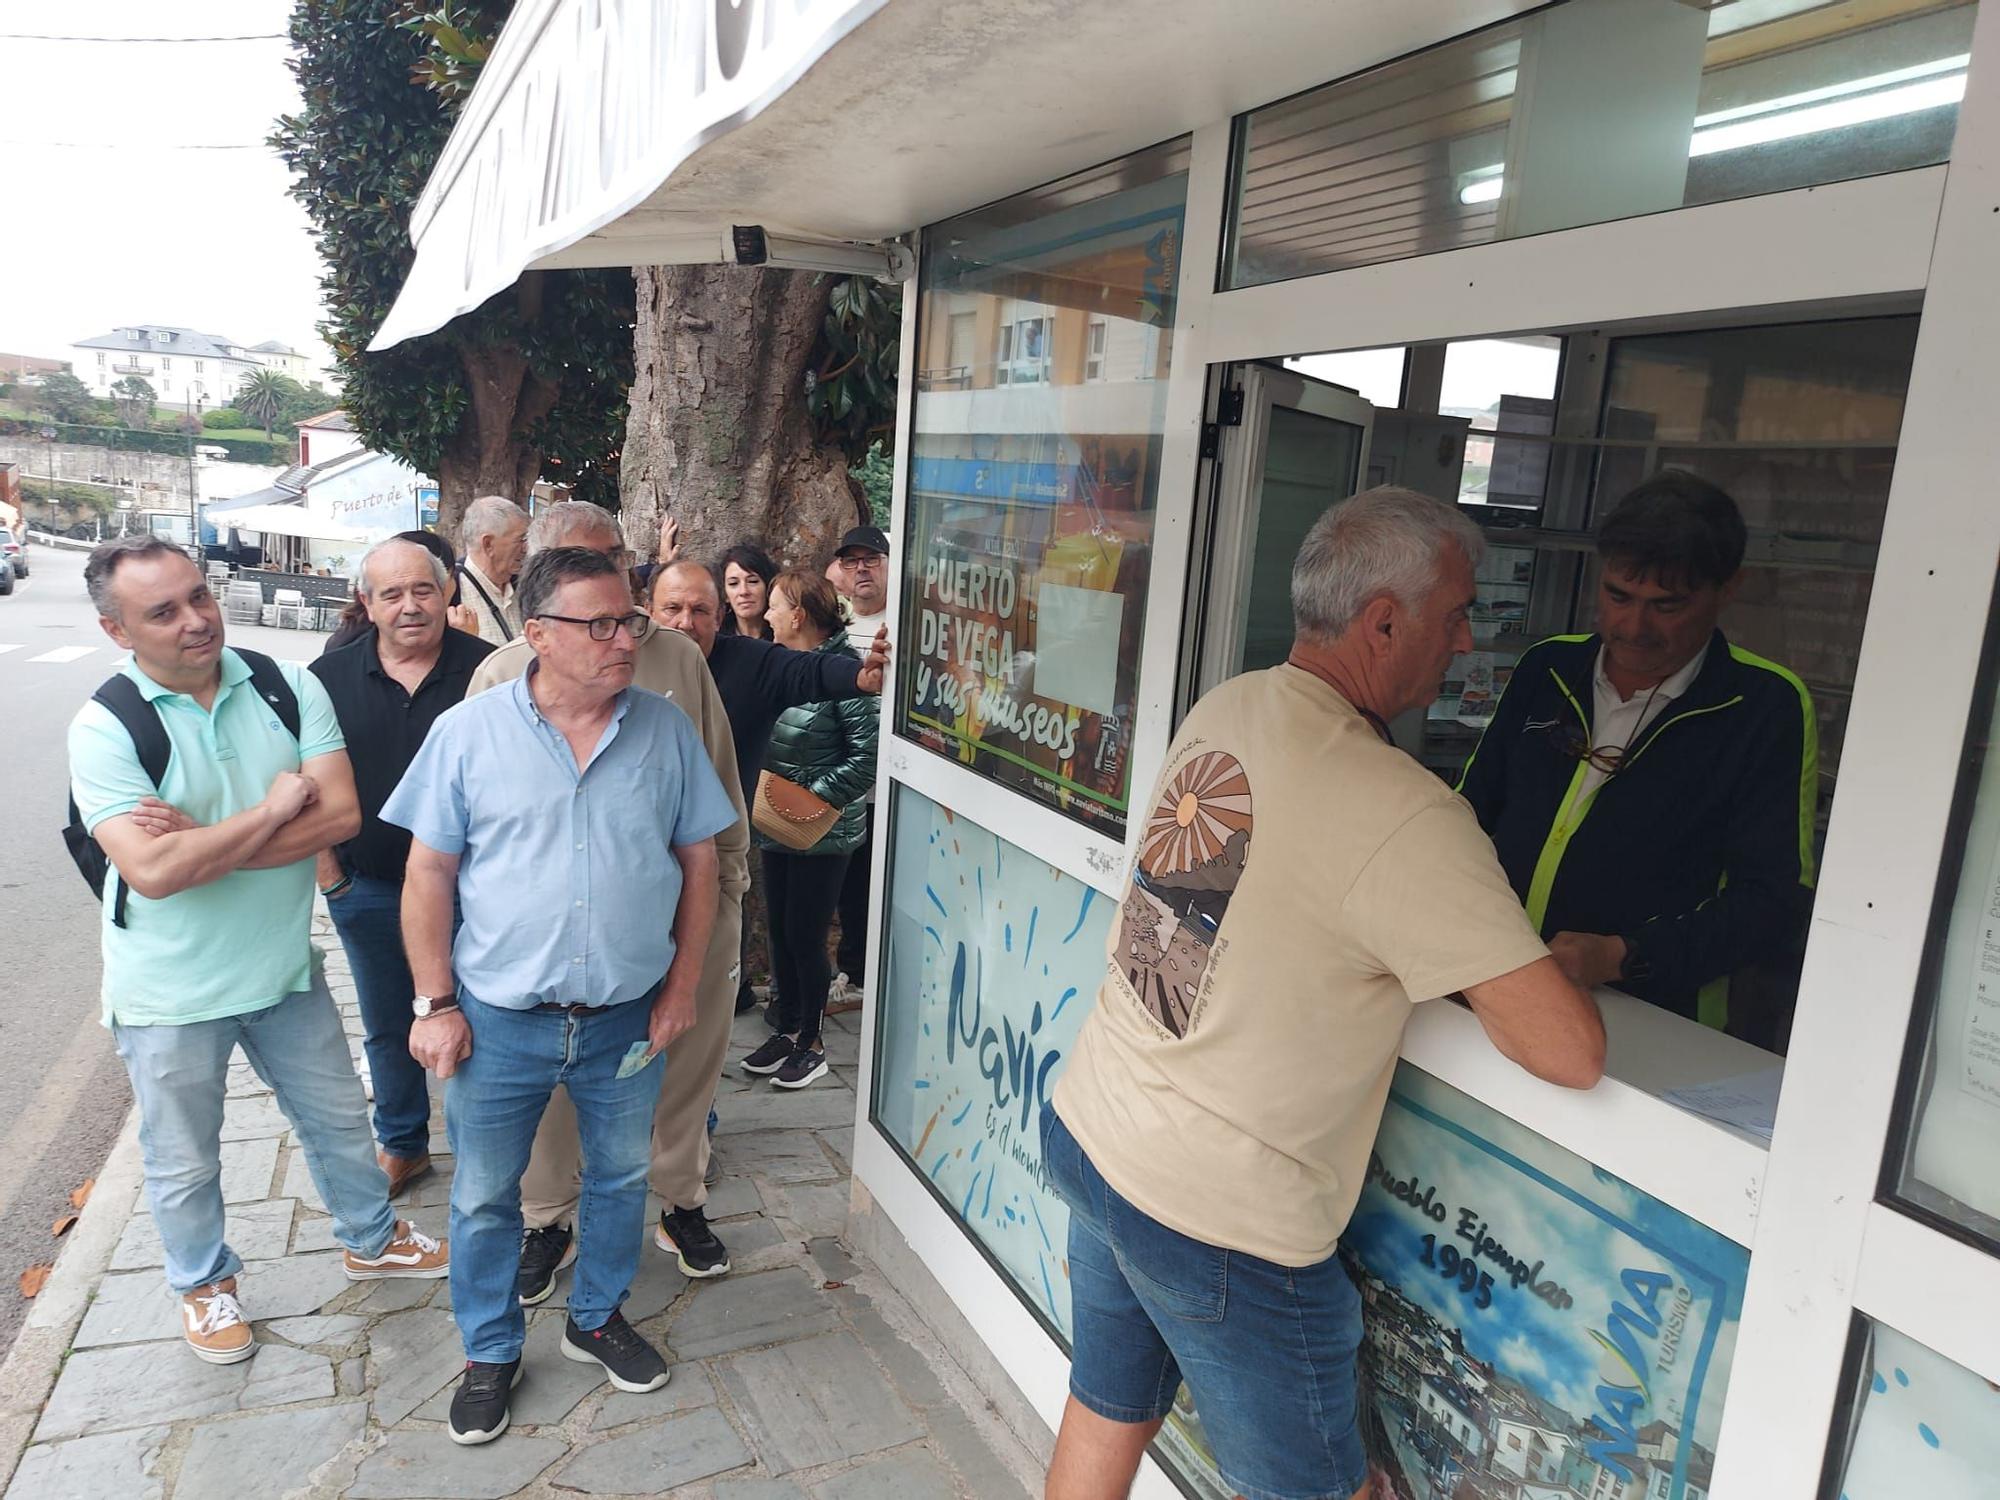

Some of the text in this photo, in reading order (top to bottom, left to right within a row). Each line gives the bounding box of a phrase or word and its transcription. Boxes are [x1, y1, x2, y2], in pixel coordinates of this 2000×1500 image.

[331, 493, 383, 520] Puerto
[387, 485, 402, 506] de
[923, 556, 1016, 619] PUERTO
[920, 609, 1016, 685] DE VEGA
[915, 660, 932, 706] y
[933, 671, 974, 717] sus
[976, 685, 1081, 760] museos
[1366, 1152, 1574, 1310] Pueblo Ejemplar
[1419, 1233, 1495, 1310] 1995
[1655, 1286, 1694, 1375] TURISMO
[1583, 1267, 1673, 1485] NAVIA
